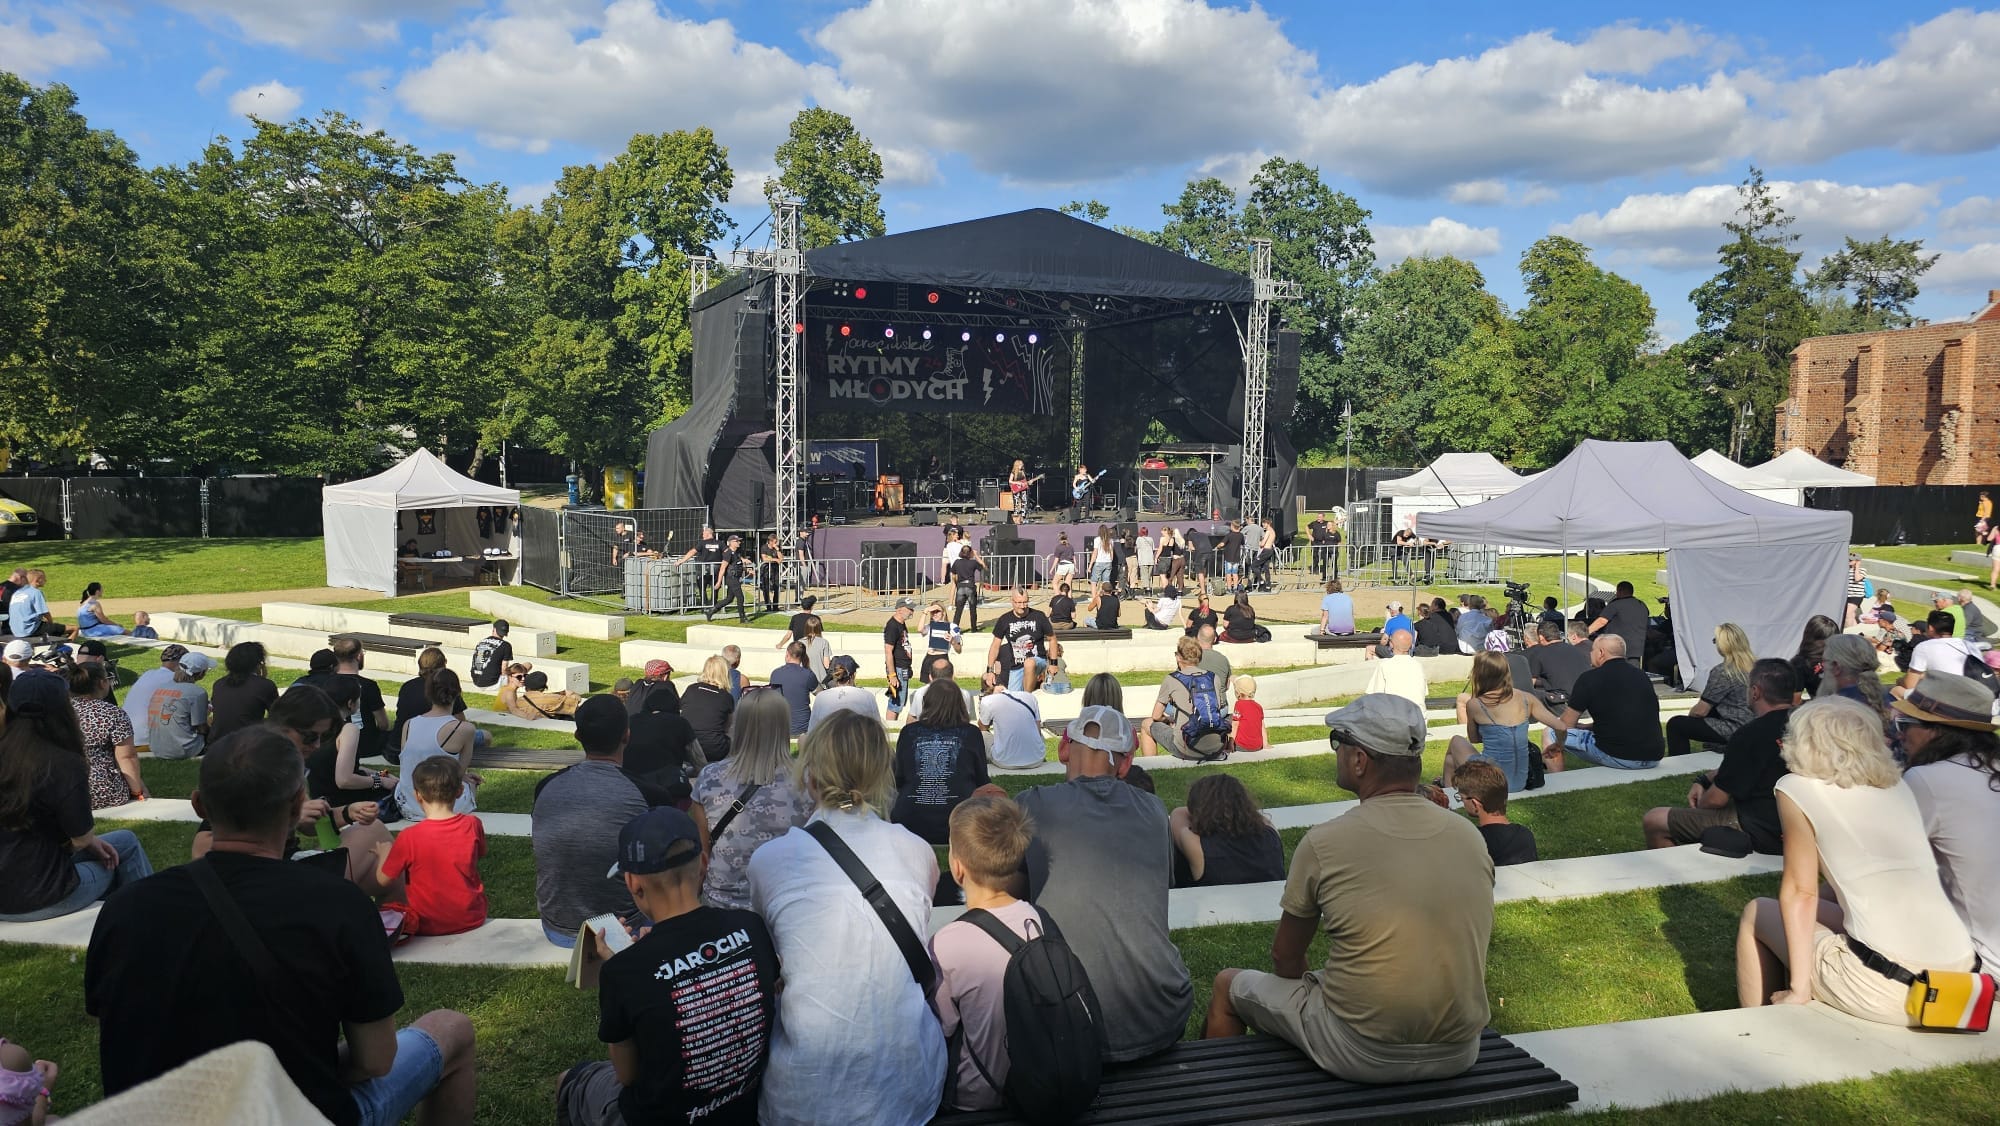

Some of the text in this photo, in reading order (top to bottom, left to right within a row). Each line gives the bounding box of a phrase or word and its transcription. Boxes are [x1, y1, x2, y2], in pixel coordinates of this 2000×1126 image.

[827, 355, 920, 375] RYTMY
[829, 378, 967, 401] MŁODYCH
[660, 928, 750, 980] JAROCIN
